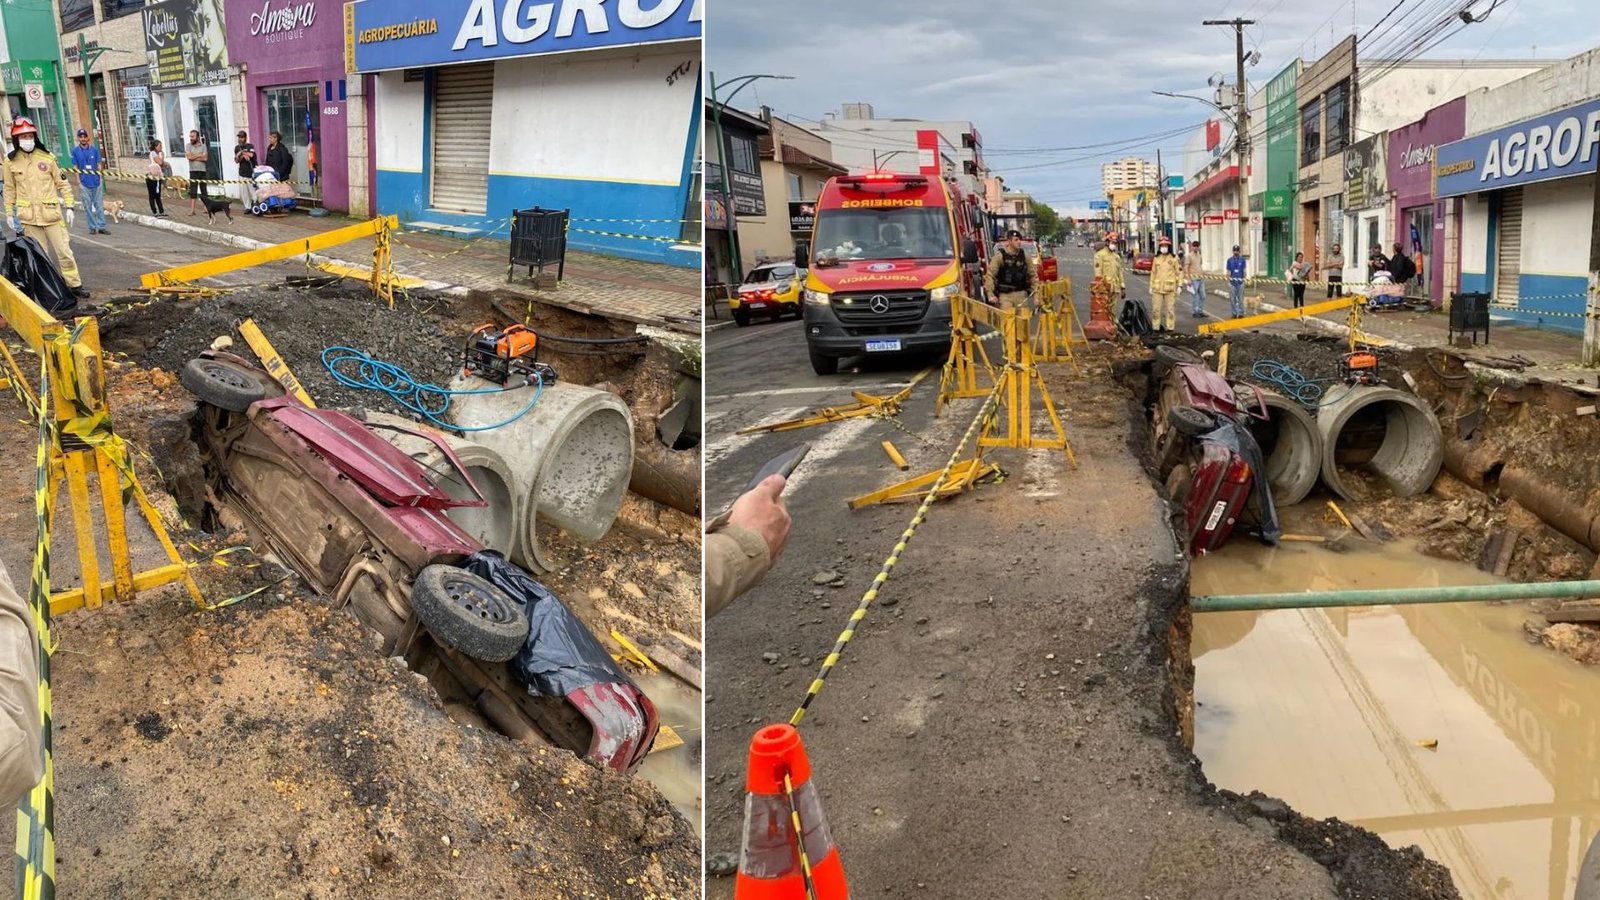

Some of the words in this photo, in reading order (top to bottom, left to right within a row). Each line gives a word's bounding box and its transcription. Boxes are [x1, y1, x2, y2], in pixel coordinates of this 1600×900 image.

[250, 0, 317, 36] Amora
[358, 17, 439, 44] AGROPECUÁRIA
[265, 28, 304, 44] BOUTIQUE
